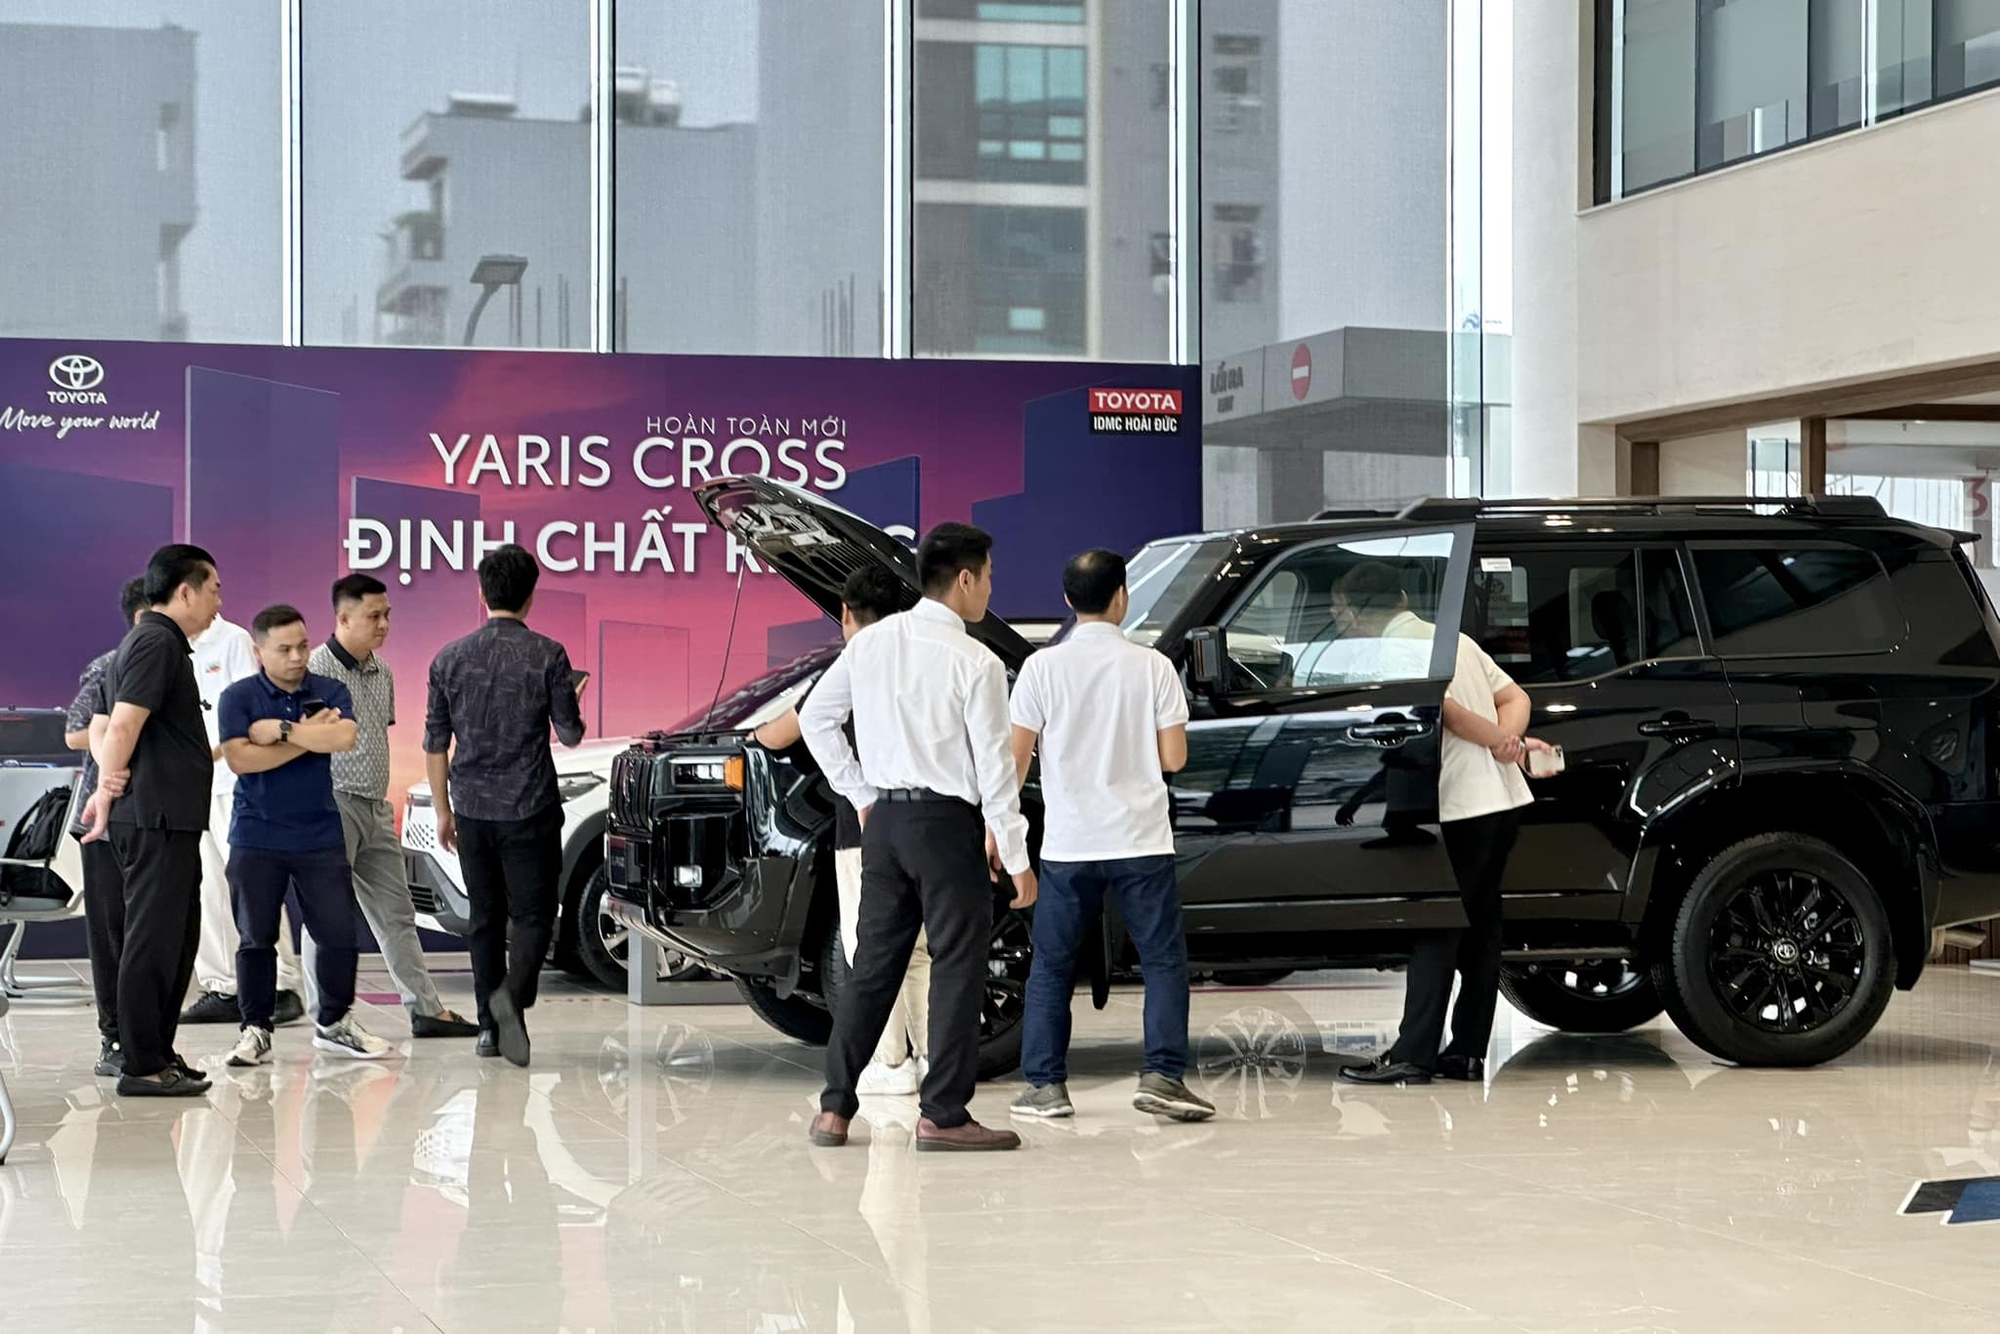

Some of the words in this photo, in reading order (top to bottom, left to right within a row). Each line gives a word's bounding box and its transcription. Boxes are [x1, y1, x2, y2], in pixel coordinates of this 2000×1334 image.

[47, 391, 107, 404] TOYOTA
[1094, 392, 1176, 410] TOYOTA
[0, 406, 55, 432] Move
[56, 417, 105, 439] your
[109, 410, 160, 430] world
[646, 413, 715, 435] HOÀN
[726, 414, 790, 436] TOÀN
[801, 415, 846, 437] MỚI
[1094, 416, 1122, 430] IDMC
[1125, 414, 1151, 431] HOÀI
[1154, 415, 1177, 432] ĐỨC
[430, 433, 611, 488] YARIS
[633, 437, 847, 490] CROSS
[343, 518, 515, 585] ĐỊNH
[536, 505, 707, 573] CHẤT
